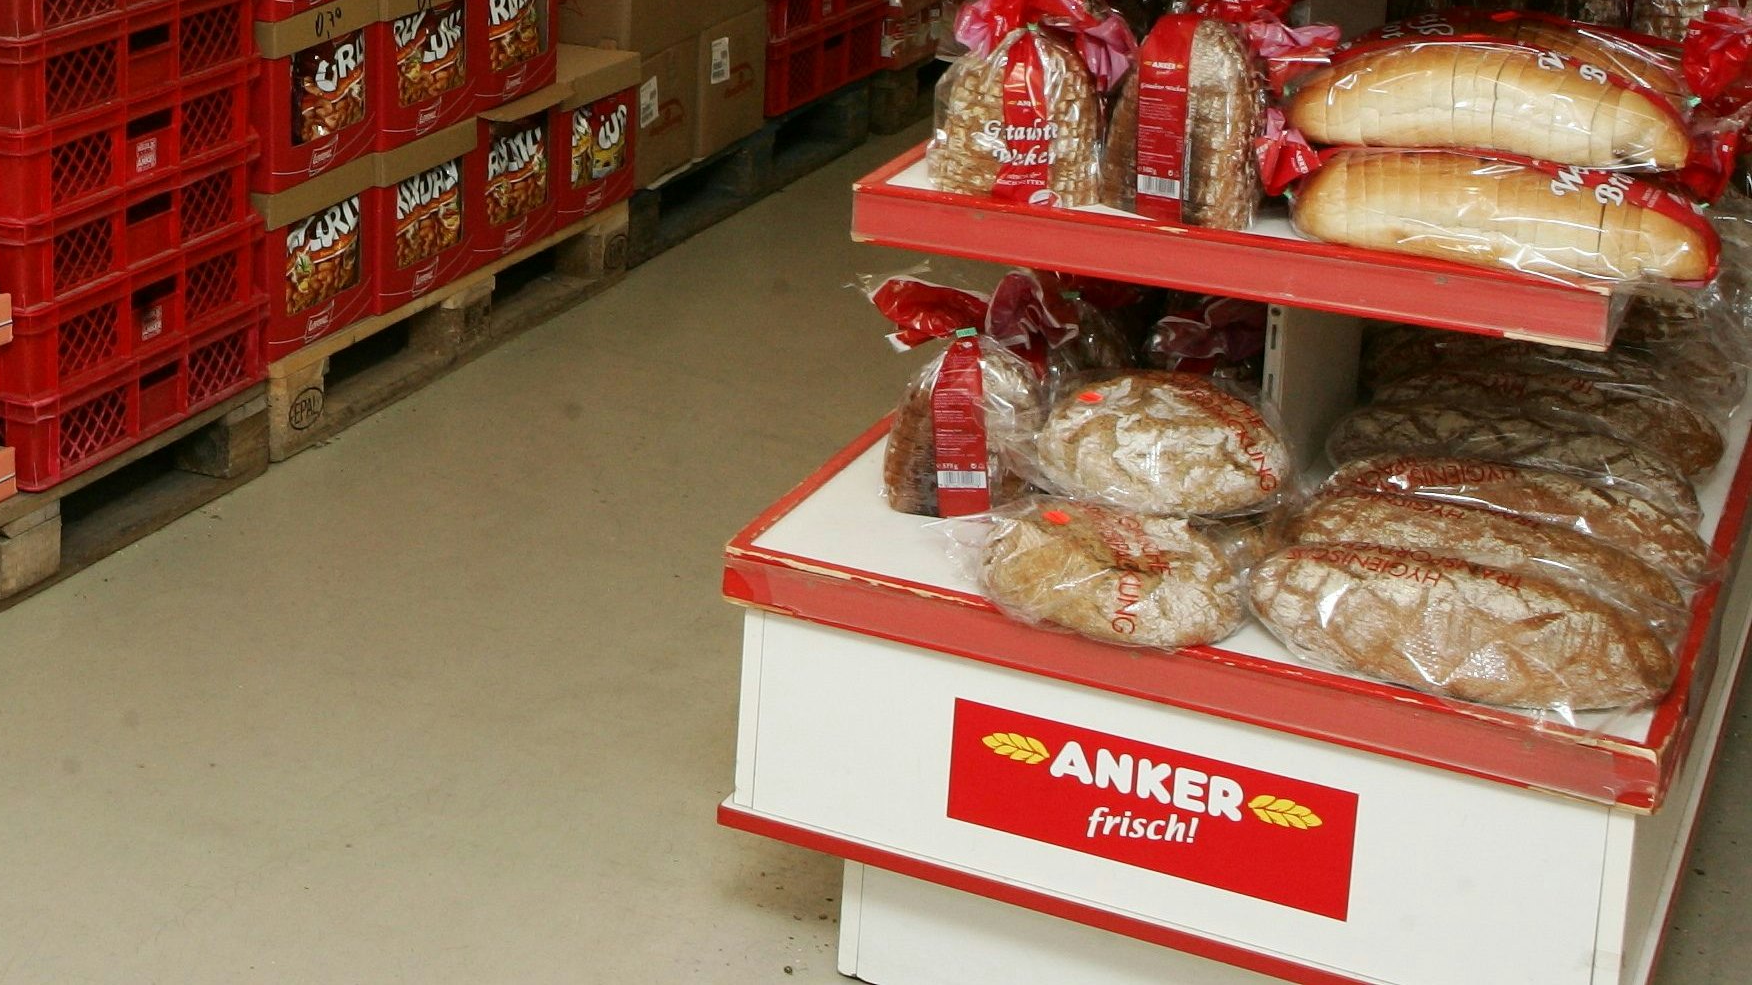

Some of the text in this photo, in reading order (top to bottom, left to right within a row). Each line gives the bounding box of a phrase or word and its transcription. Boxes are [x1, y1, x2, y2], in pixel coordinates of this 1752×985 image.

[293, 395, 320, 424] EPAL
[1049, 740, 1245, 823] ANKER
[1086, 806, 1199, 844] frisch!
